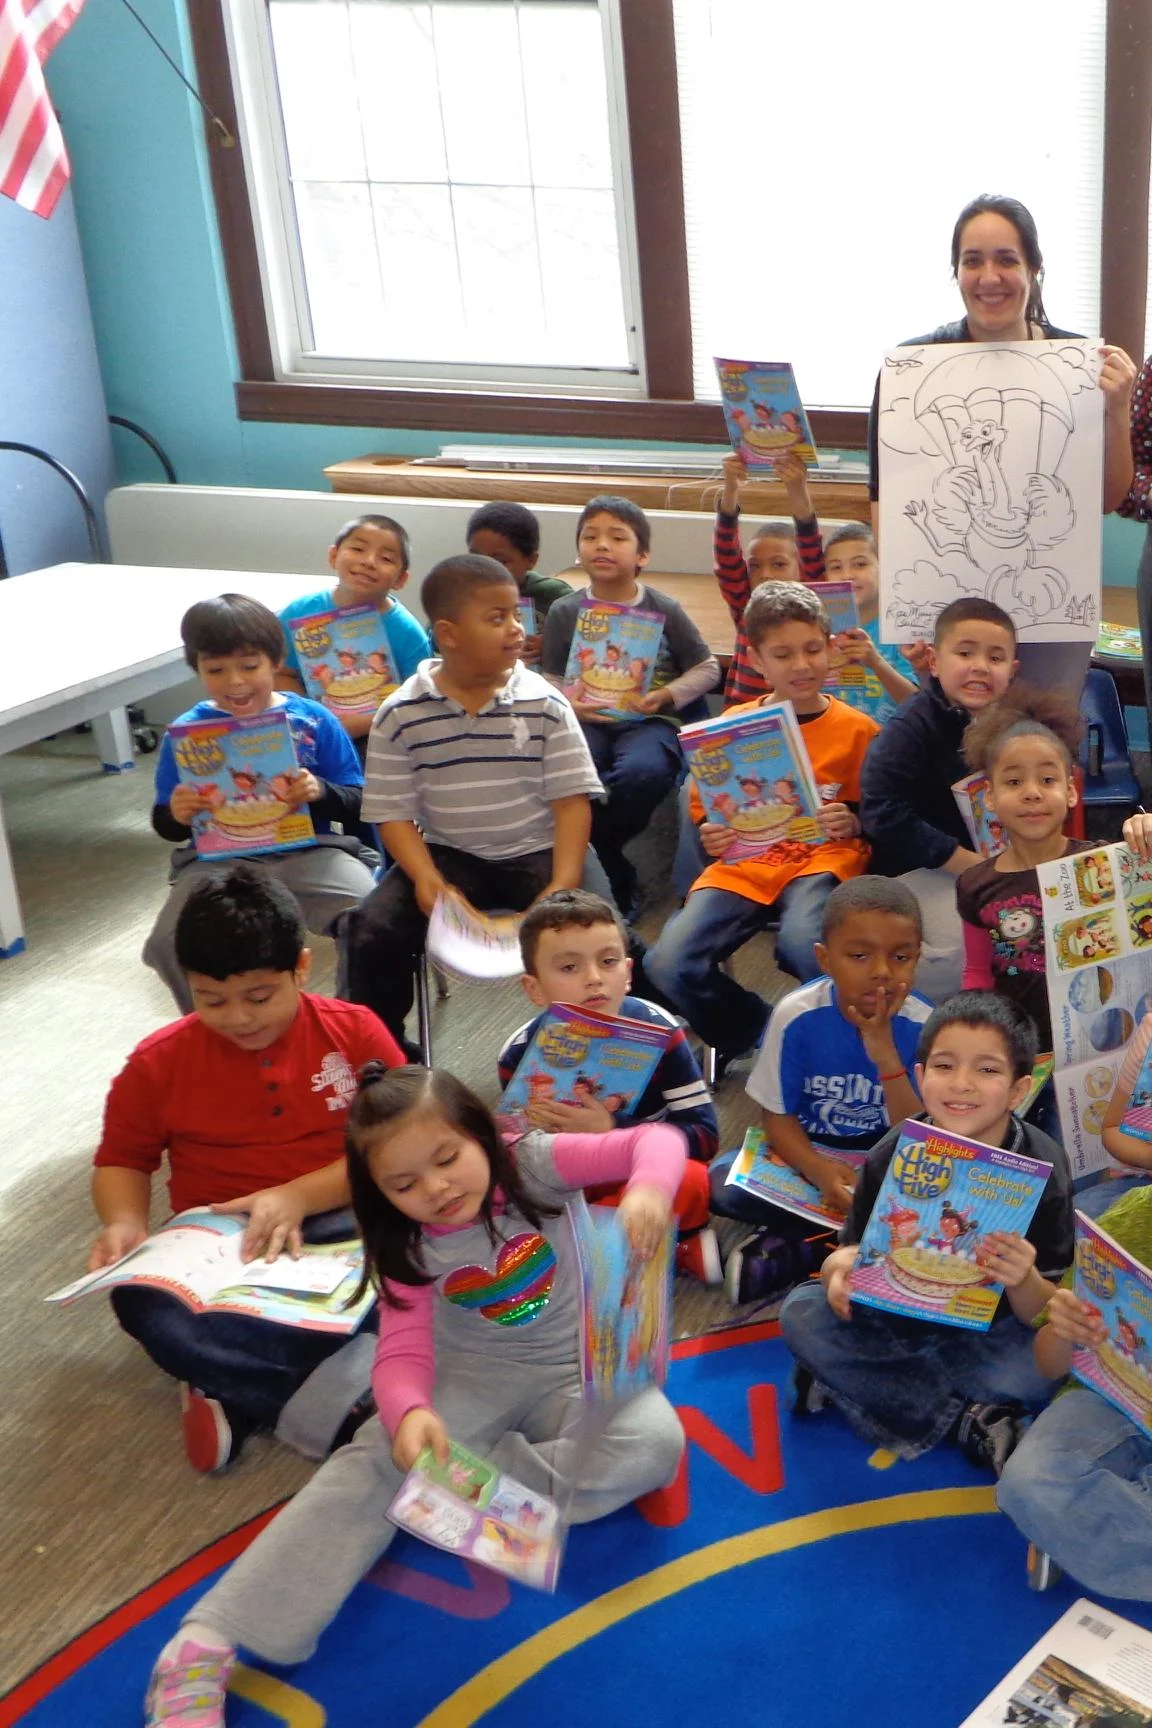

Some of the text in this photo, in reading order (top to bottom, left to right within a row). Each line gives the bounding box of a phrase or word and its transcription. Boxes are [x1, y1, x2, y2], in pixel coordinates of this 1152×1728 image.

[1062, 881, 1073, 897] the
[1064, 900, 1075, 912] At
[926, 1137, 977, 1159] Highlights
[899, 1145, 950, 1181] High
[899, 1171, 941, 1198] Five
[968, 1167, 1033, 1196] Celebrate
[969, 1186, 997, 1201] with
